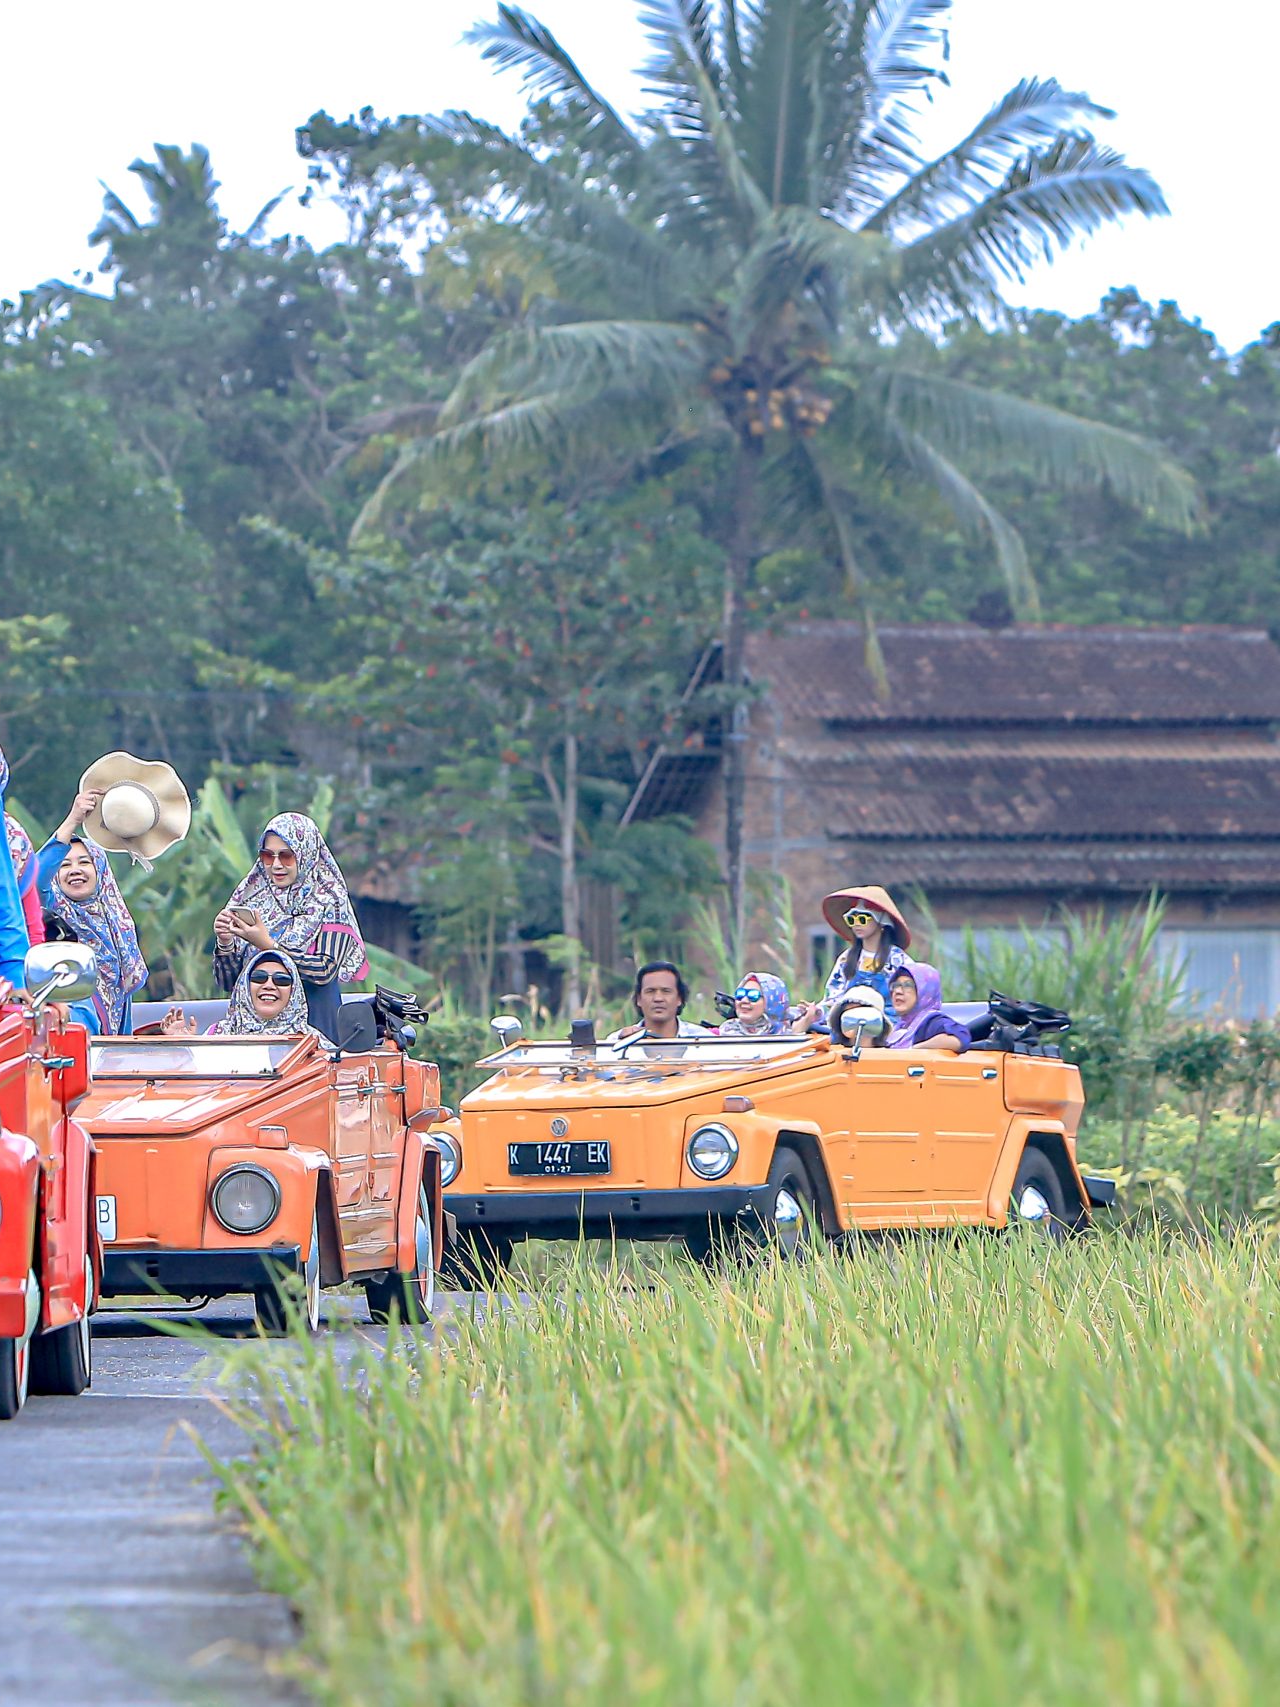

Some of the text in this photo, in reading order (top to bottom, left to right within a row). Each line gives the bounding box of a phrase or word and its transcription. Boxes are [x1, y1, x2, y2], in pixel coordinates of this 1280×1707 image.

[509, 1143, 607, 1165] K 1447 EK
[98, 1199, 110, 1223] B
